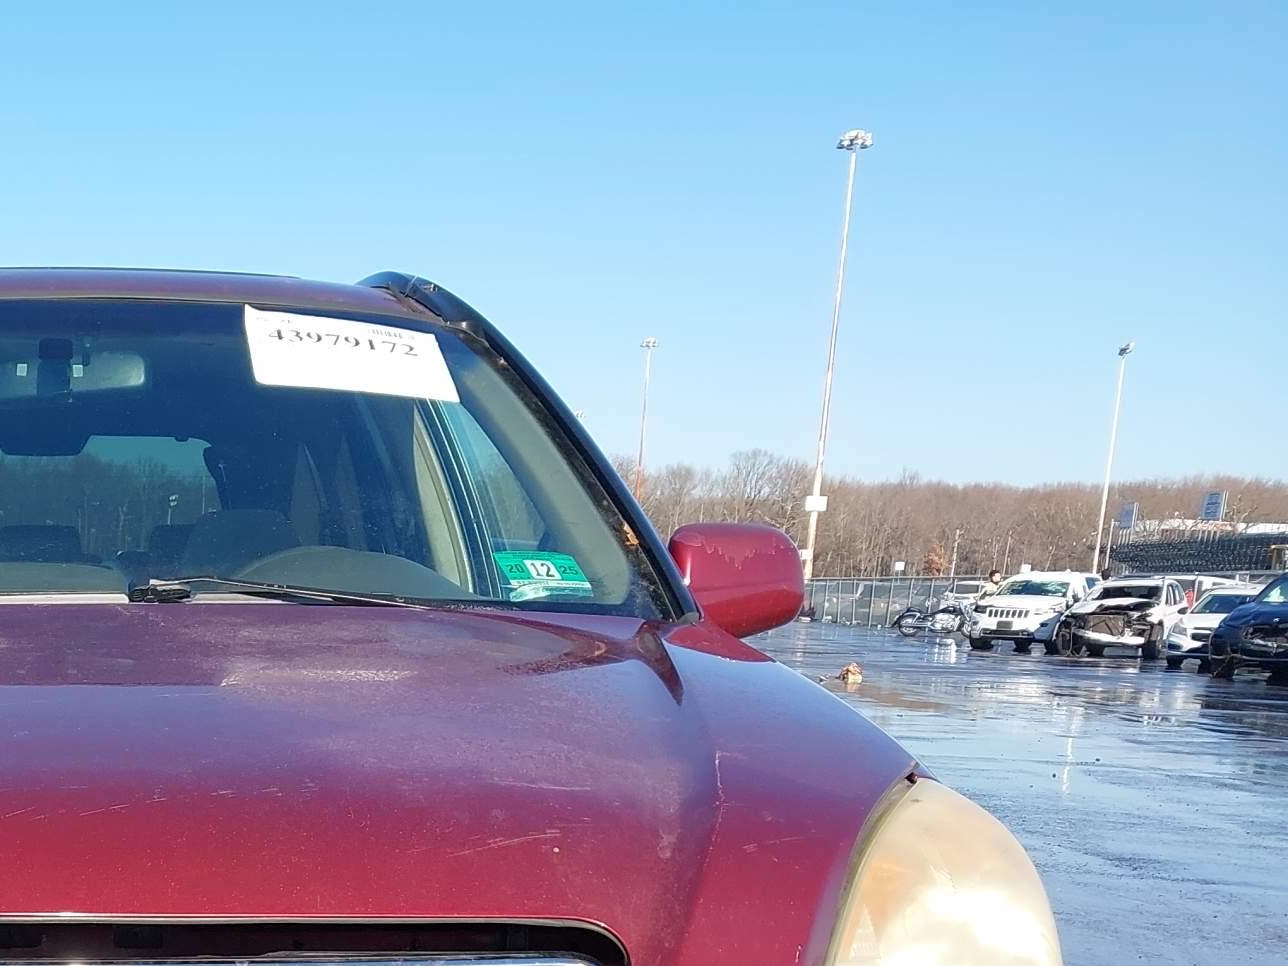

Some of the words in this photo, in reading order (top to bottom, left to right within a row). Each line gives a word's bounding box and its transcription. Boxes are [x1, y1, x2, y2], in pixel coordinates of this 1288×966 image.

[268, 328, 419, 357] 43979172
[506, 563, 525, 574] 20
[530, 562, 556, 578] 12
[559, 565, 579, 576] 25
